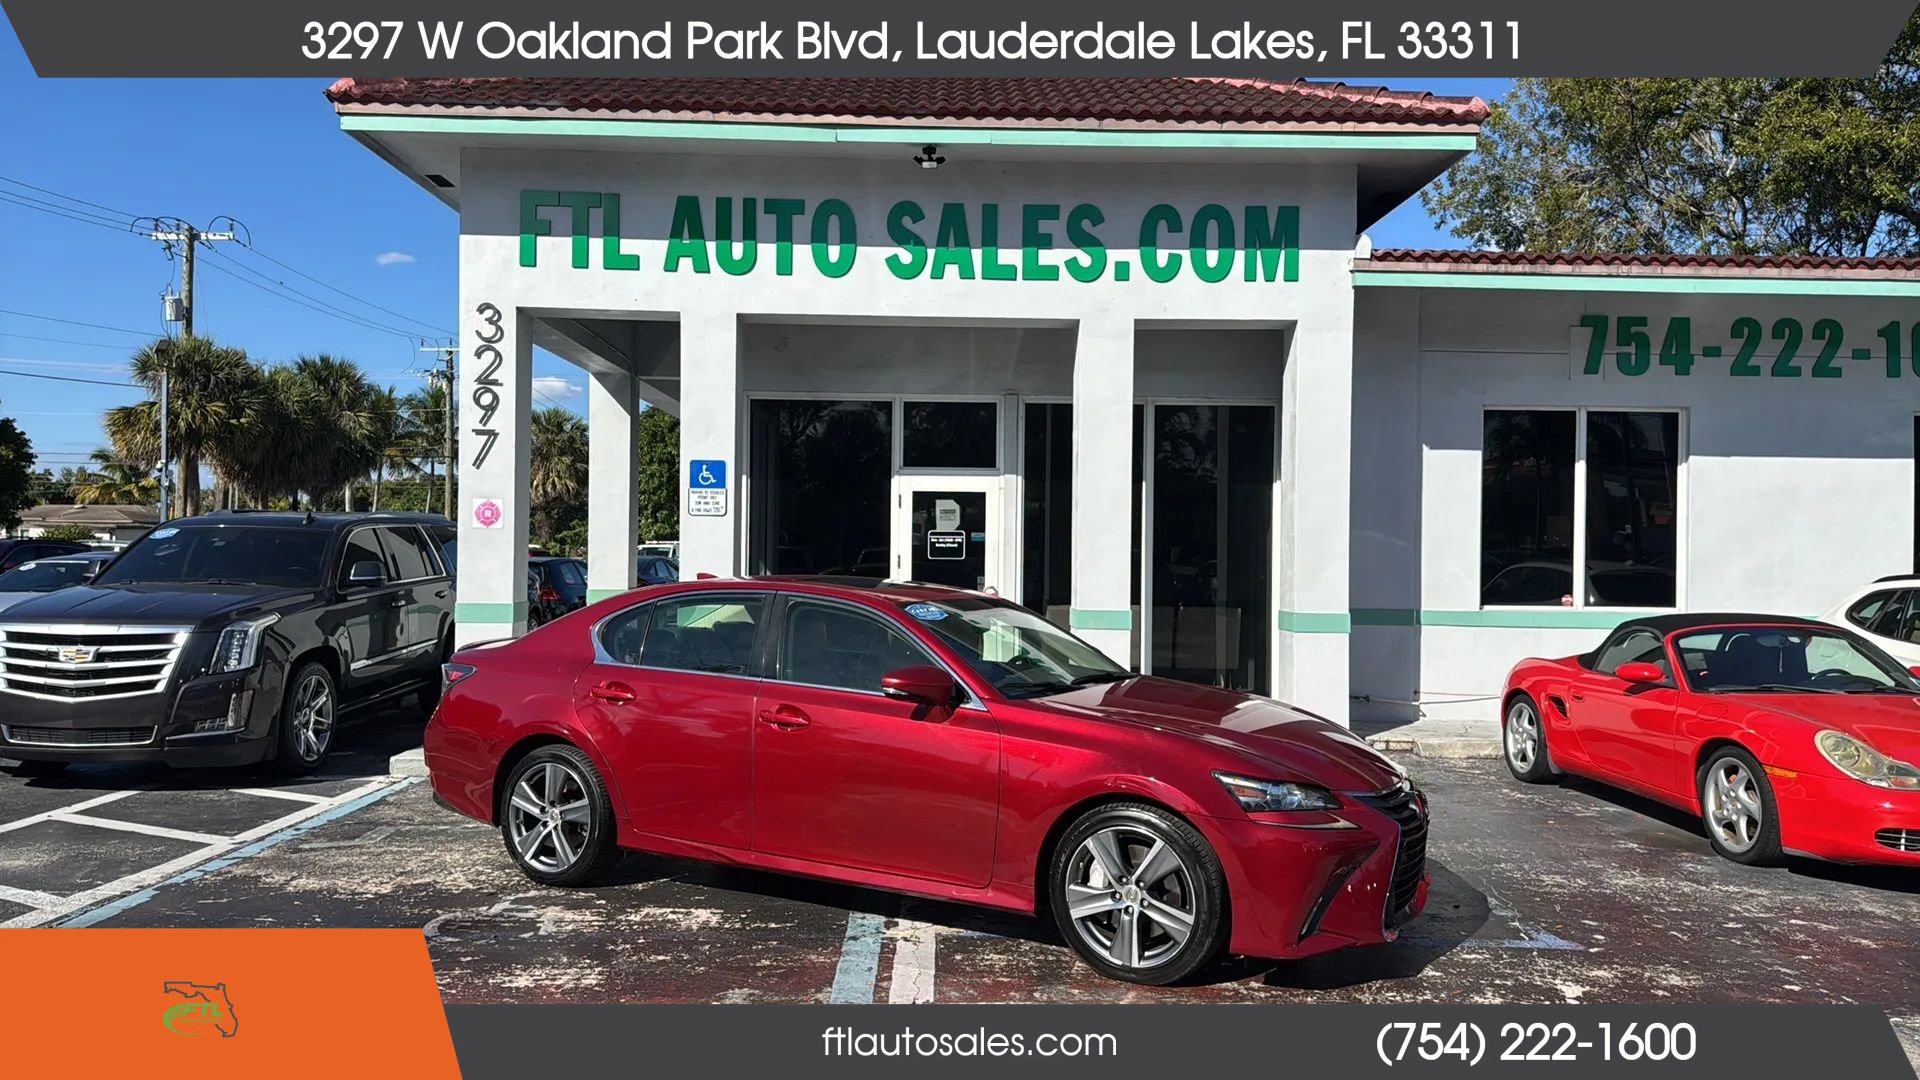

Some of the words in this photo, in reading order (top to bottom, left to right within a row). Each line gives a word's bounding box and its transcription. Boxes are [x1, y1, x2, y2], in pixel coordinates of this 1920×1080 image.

[518, 189, 641, 272] FTL
[663, 195, 858, 279] AUTO
[885, 199, 1301, 284] SALES.COM
[471, 302, 505, 471] 3297
[1580, 314, 1920, 379] 754-222-1
